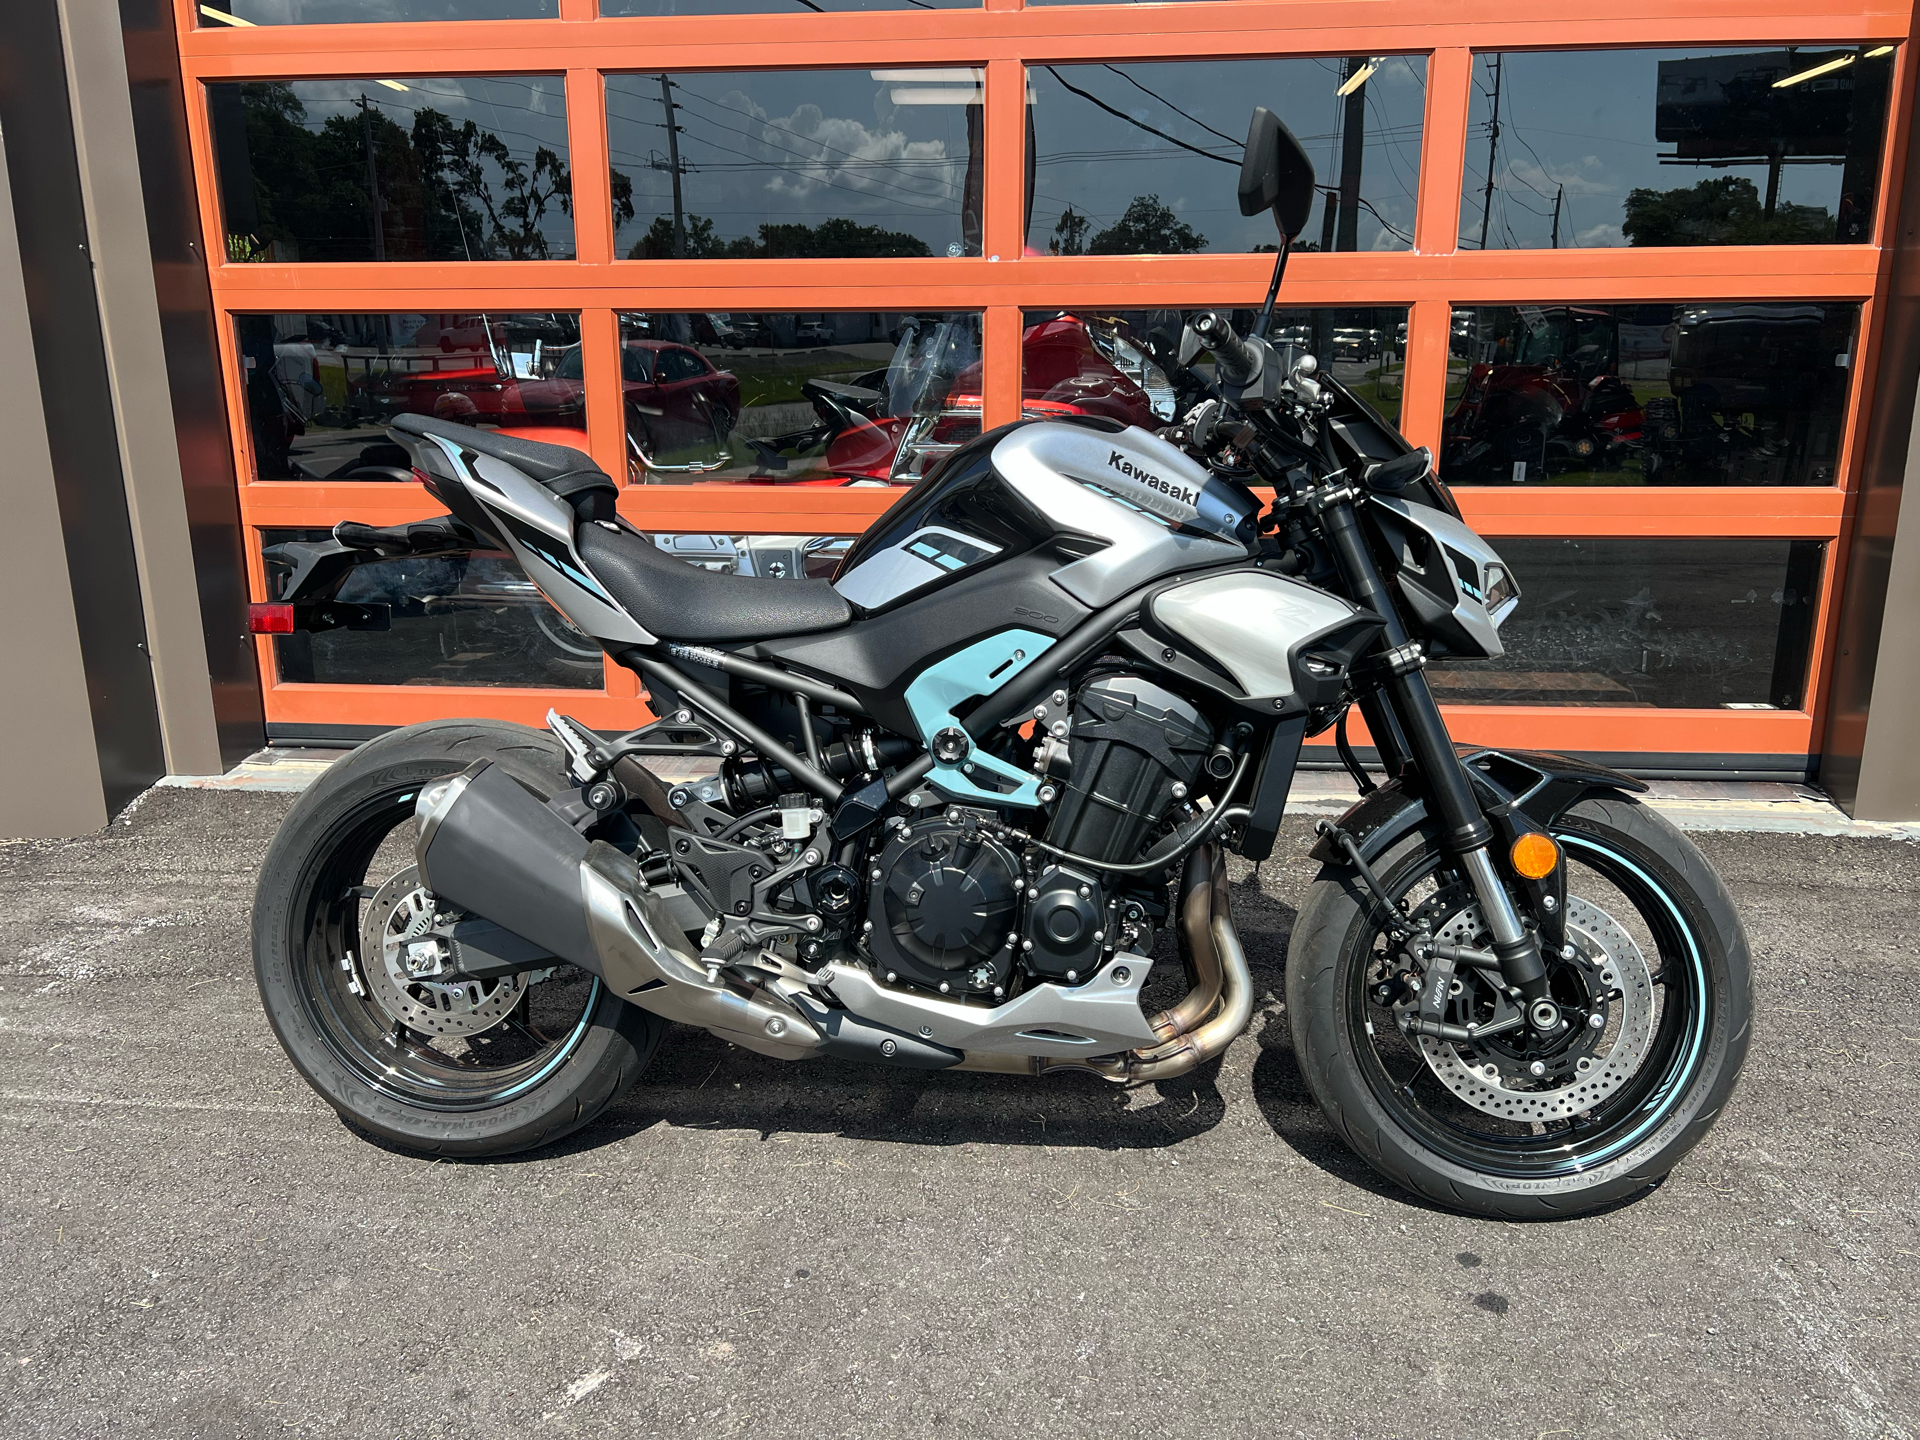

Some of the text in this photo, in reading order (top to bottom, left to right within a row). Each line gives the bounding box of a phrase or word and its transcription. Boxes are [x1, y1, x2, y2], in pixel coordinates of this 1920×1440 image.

[1107, 450, 1201, 507] Kawasaki
[1013, 606, 1059, 624] 900
[1432, 976, 1446, 1009] NISSIN
